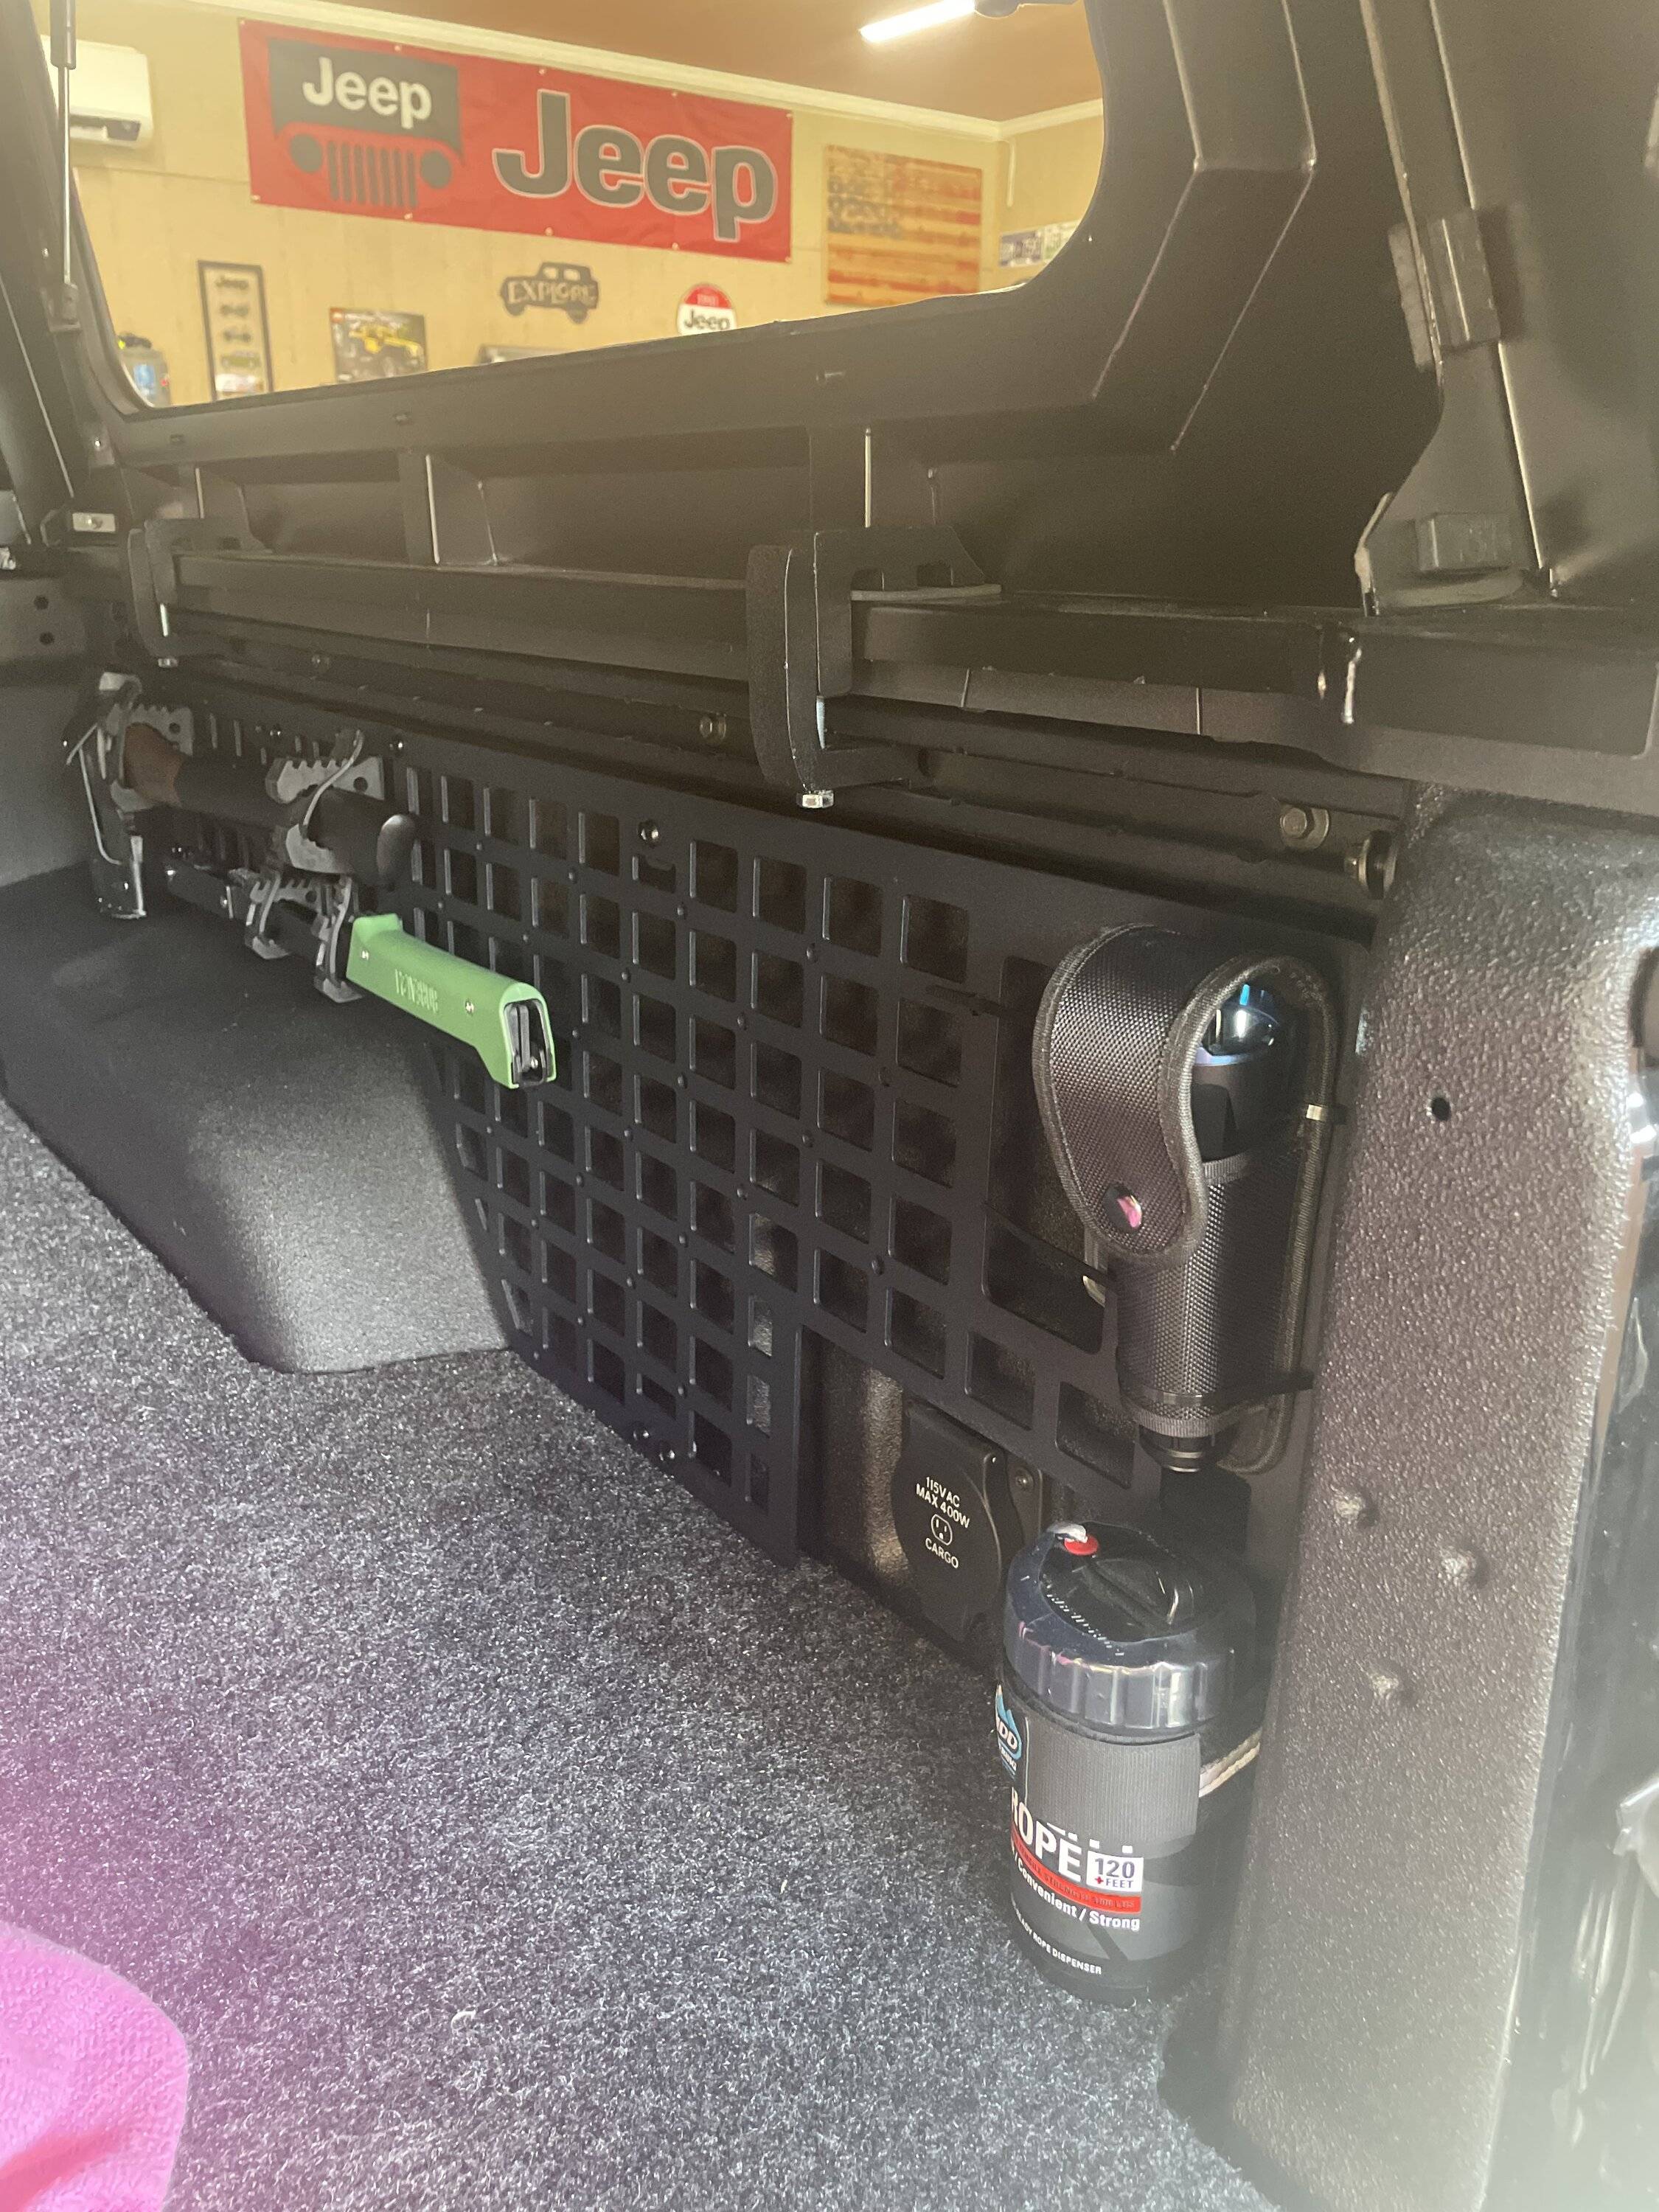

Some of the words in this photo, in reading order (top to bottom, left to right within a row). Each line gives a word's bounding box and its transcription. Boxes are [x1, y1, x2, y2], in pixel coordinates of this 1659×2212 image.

[303, 56, 432, 129] Jeep
[491, 89, 778, 243] Jeep
[507, 279, 597, 307] EXPLORE
[684, 308, 731, 330] Jeep
[916, 1484, 939, 1509] MAX
[939, 1501, 970, 1528] 400W
[925, 1476, 947, 1498] 115V
[947, 1492, 961, 1508] AC
[925, 1537, 959, 1569] CARGO
[1012, 1786, 1082, 1883] ROPE
[1095, 1857, 1135, 1879] 120
[1018, 1857, 1077, 1919] Convenient
[1089, 1910, 1140, 1931] Strong
[1033, 1931, 1051, 1954] ROPE
[1052, 1947, 1102, 1975] DISPENSER
